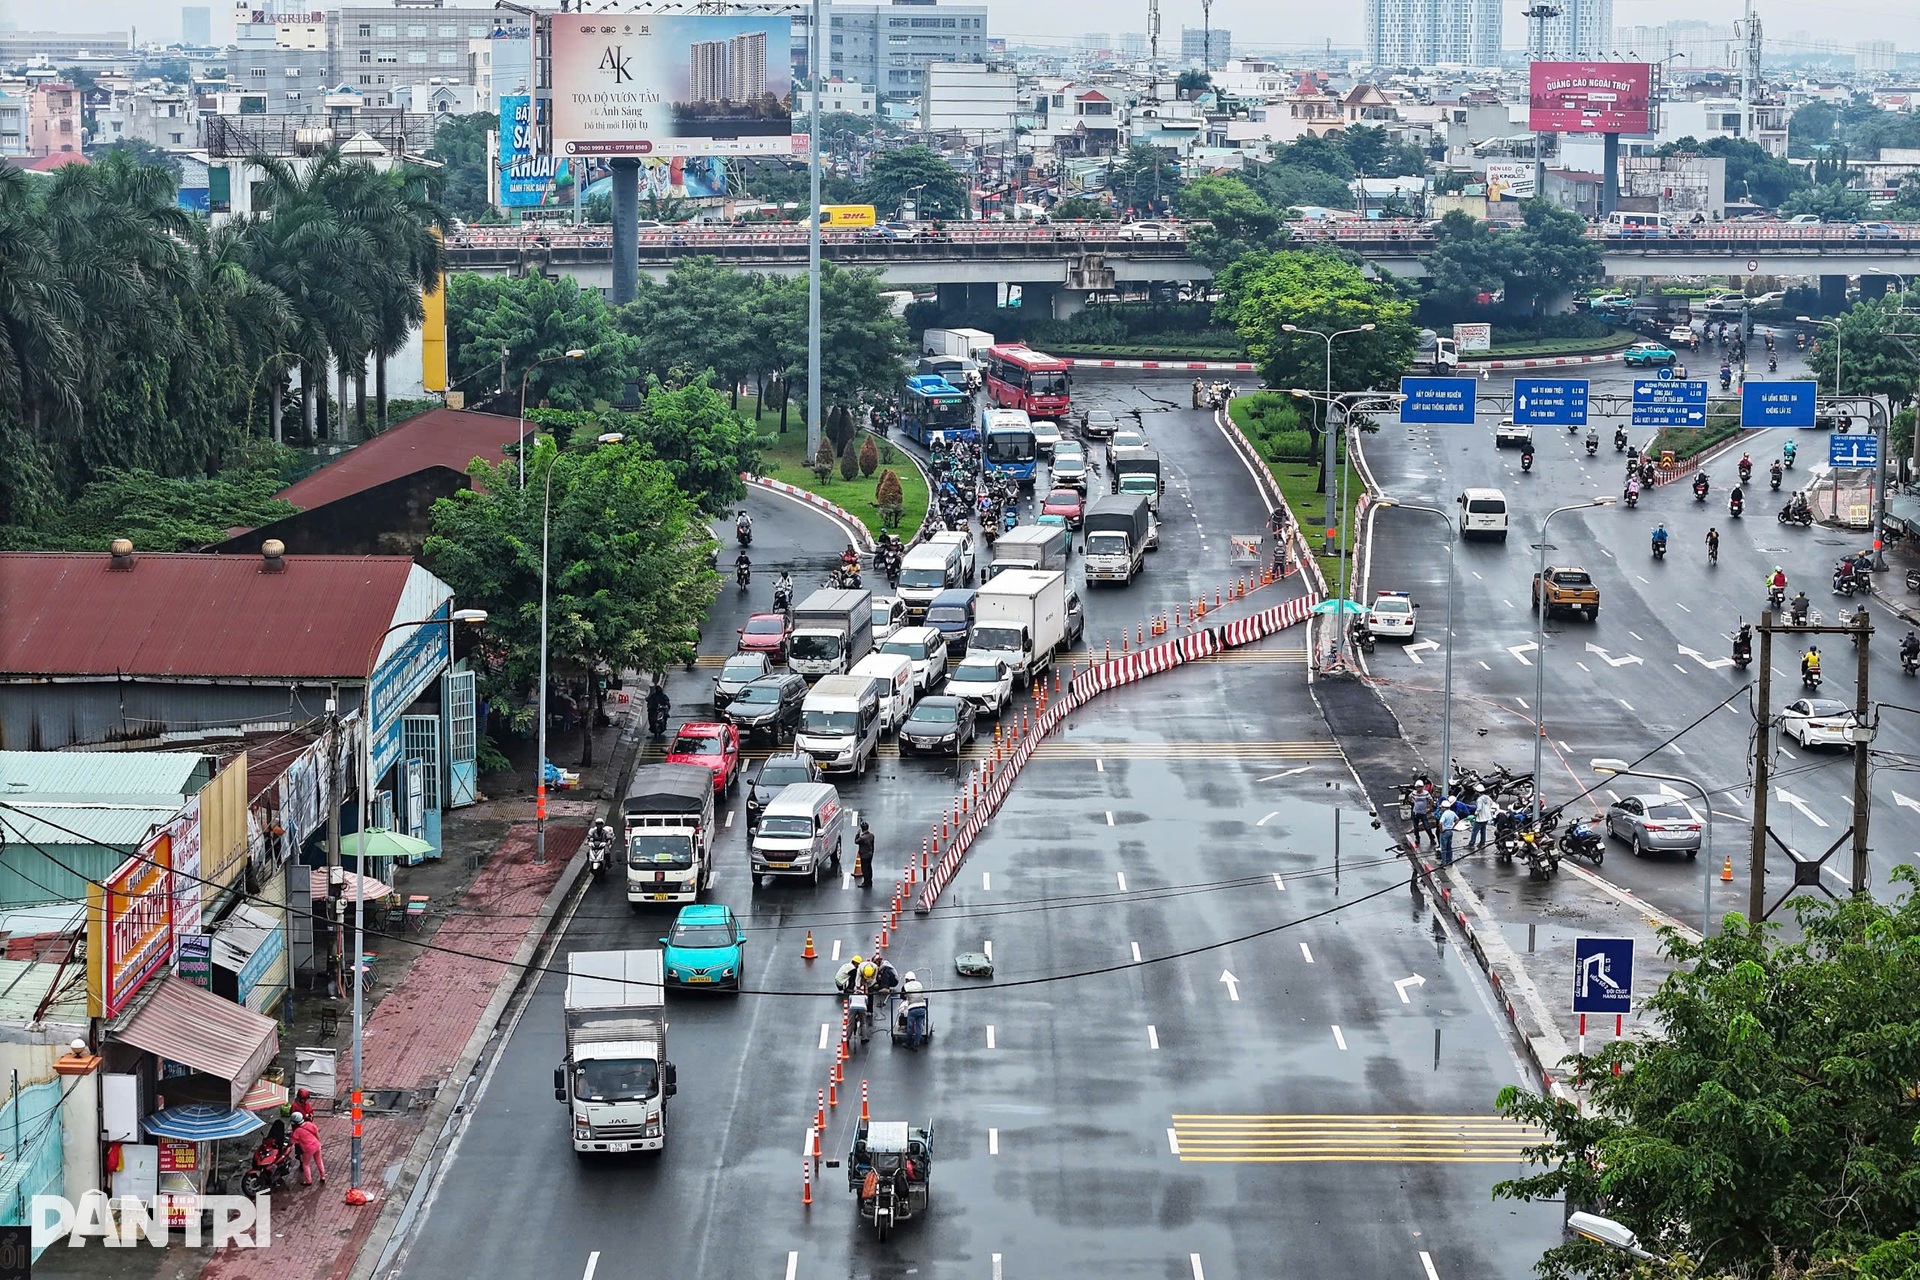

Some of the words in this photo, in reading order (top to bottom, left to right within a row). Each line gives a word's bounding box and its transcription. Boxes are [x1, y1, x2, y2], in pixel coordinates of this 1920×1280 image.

[621, 104, 643, 117] Sáng
[621, 119, 637, 131] Hội
[639, 120, 648, 131] tụ
